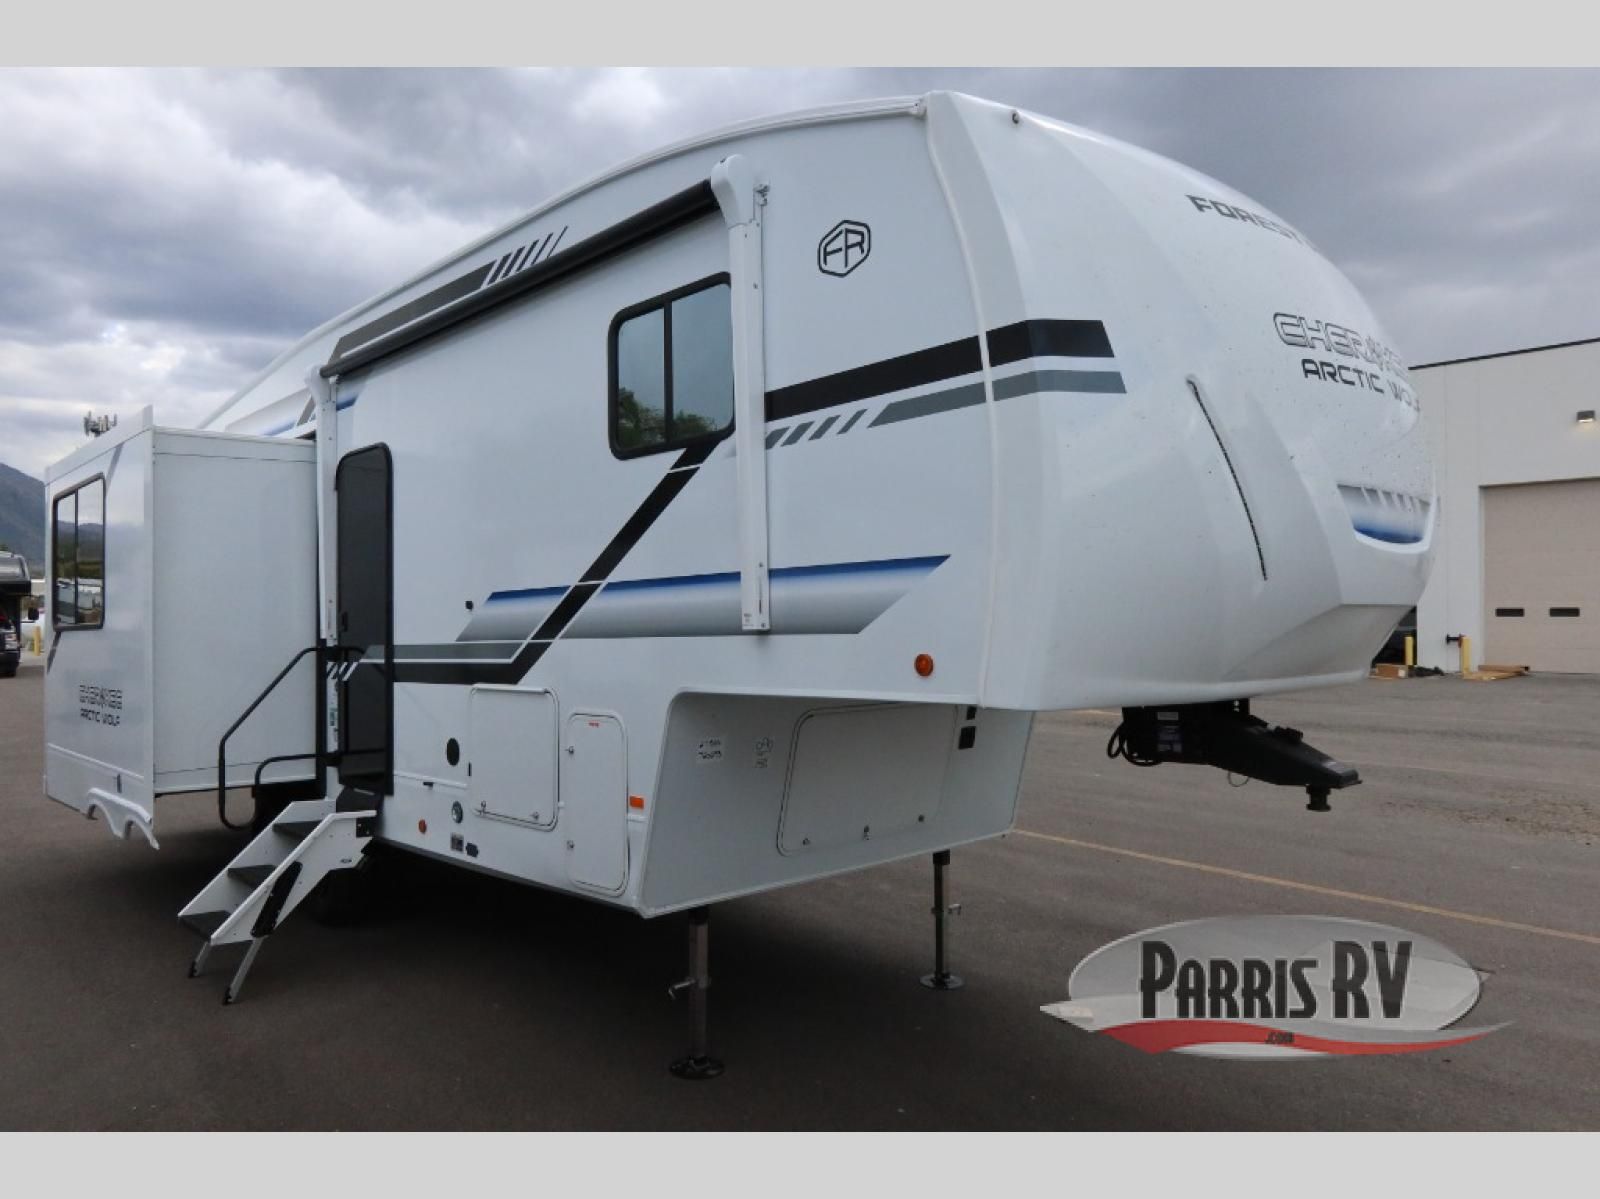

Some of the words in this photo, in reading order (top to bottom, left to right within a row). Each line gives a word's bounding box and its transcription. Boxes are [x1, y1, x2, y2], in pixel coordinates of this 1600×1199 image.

[823, 228, 865, 268] FR
[1273, 312, 1408, 381] CHER
[1301, 358, 1385, 394] ARCTIC
